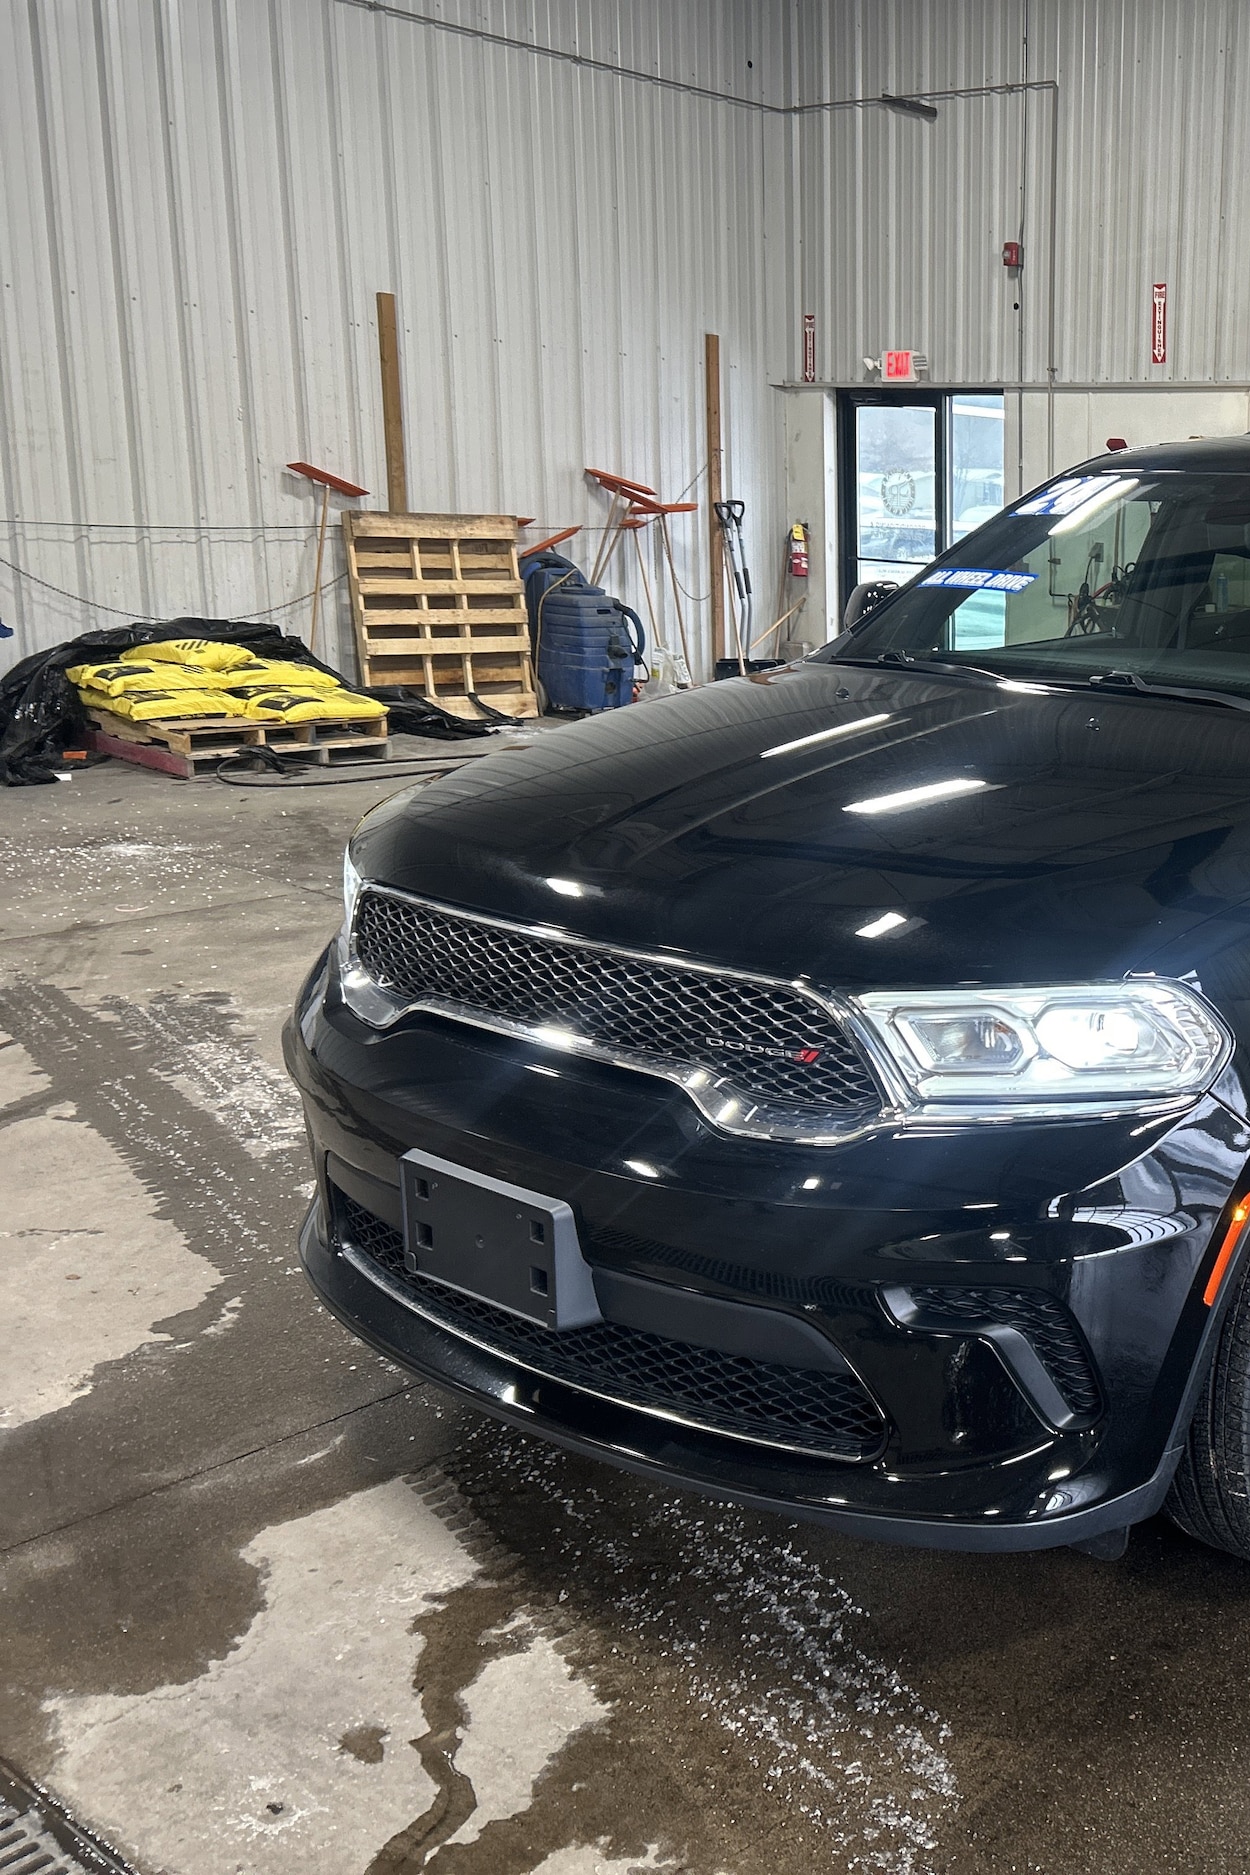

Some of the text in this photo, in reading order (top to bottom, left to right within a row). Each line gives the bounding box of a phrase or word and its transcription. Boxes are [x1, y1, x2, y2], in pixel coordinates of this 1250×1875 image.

[1155, 291, 1165, 299] FIRE
[887, 352, 910, 377] EXIT
[944, 571, 993, 586] WHEEL
[984, 573, 1035, 590] DRIVE
[705, 1036, 804, 1060] DODGE
